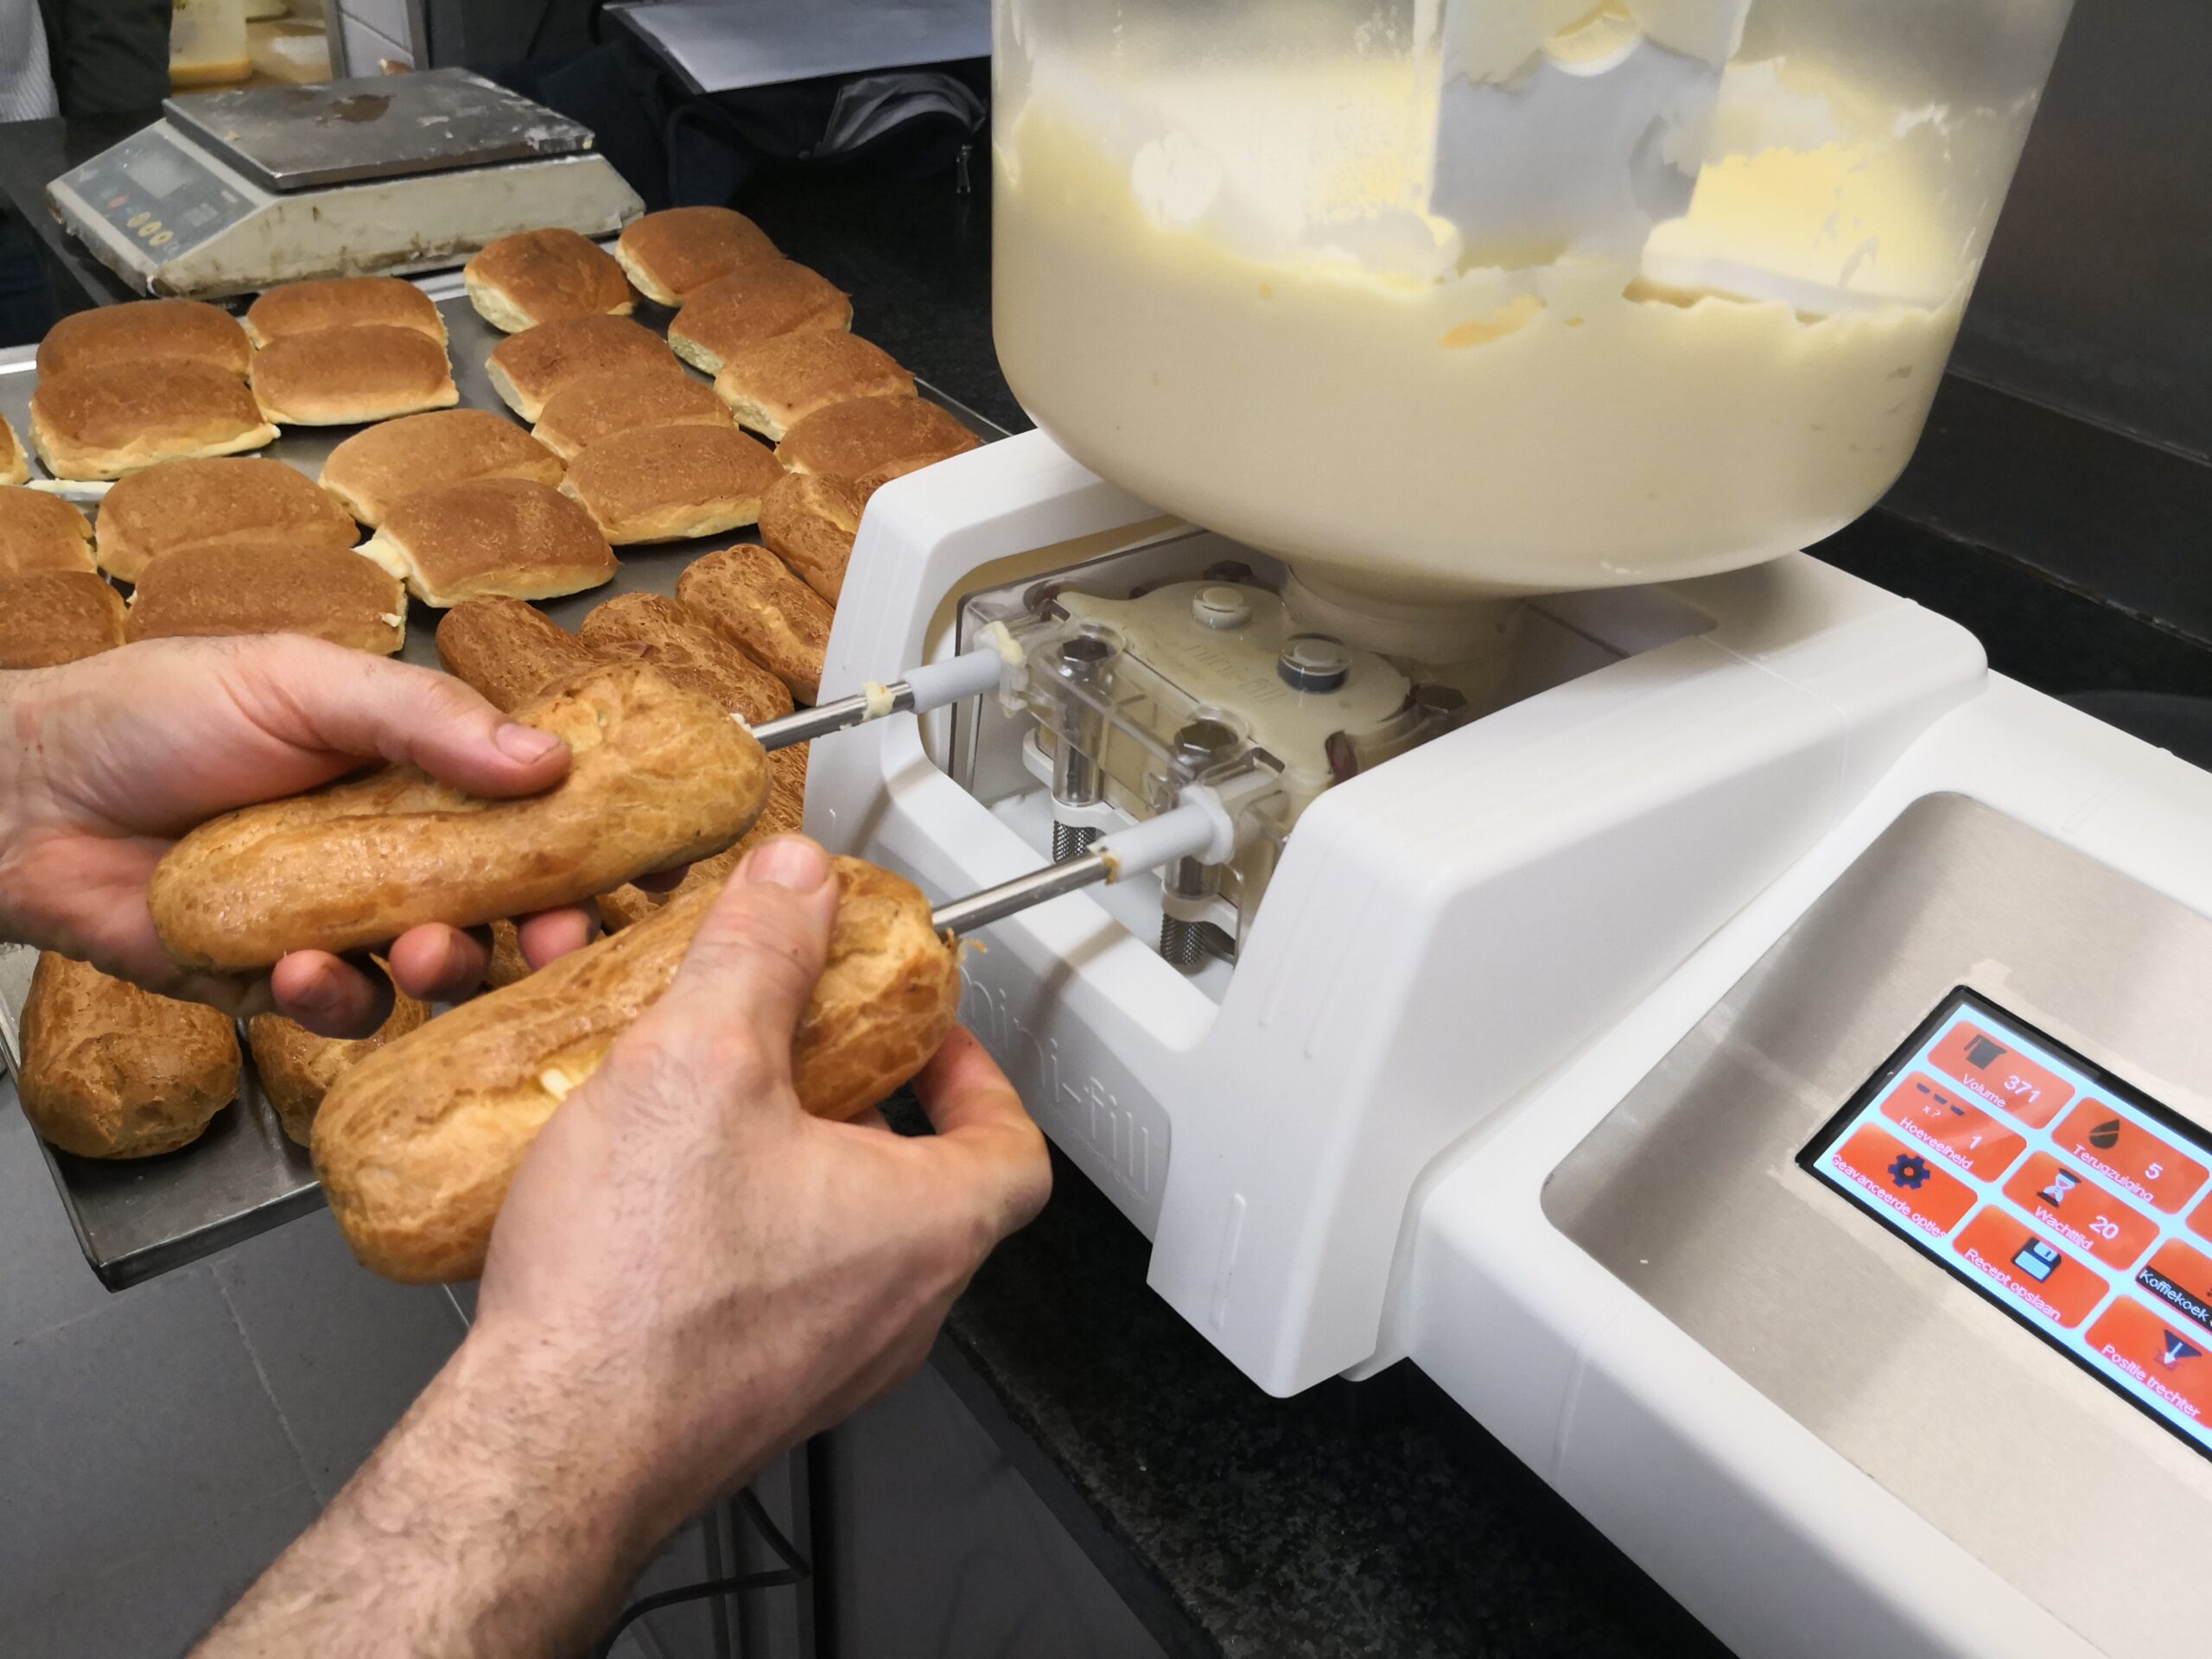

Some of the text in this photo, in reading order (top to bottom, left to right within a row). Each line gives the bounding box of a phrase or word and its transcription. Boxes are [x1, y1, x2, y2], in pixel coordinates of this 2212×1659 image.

[1962, 1073, 2007, 1109] Volume
[2003, 1074, 2042, 1104] 371
[1899, 1116, 1974, 1171] Hoeveelheid
[1969, 1135, 1983, 1150] 1
[2145, 1162, 2164, 1180] 5
[1831, 1154, 1948, 1239] Geavanceerde opties
[2088, 1215, 2120, 1240] 20
[1964, 1248, 2062, 1322] Recept opslaan
[2139, 1268, 2210, 1323] Koffiekoek
[2101, 1344, 2202, 1419] Positie trechter
